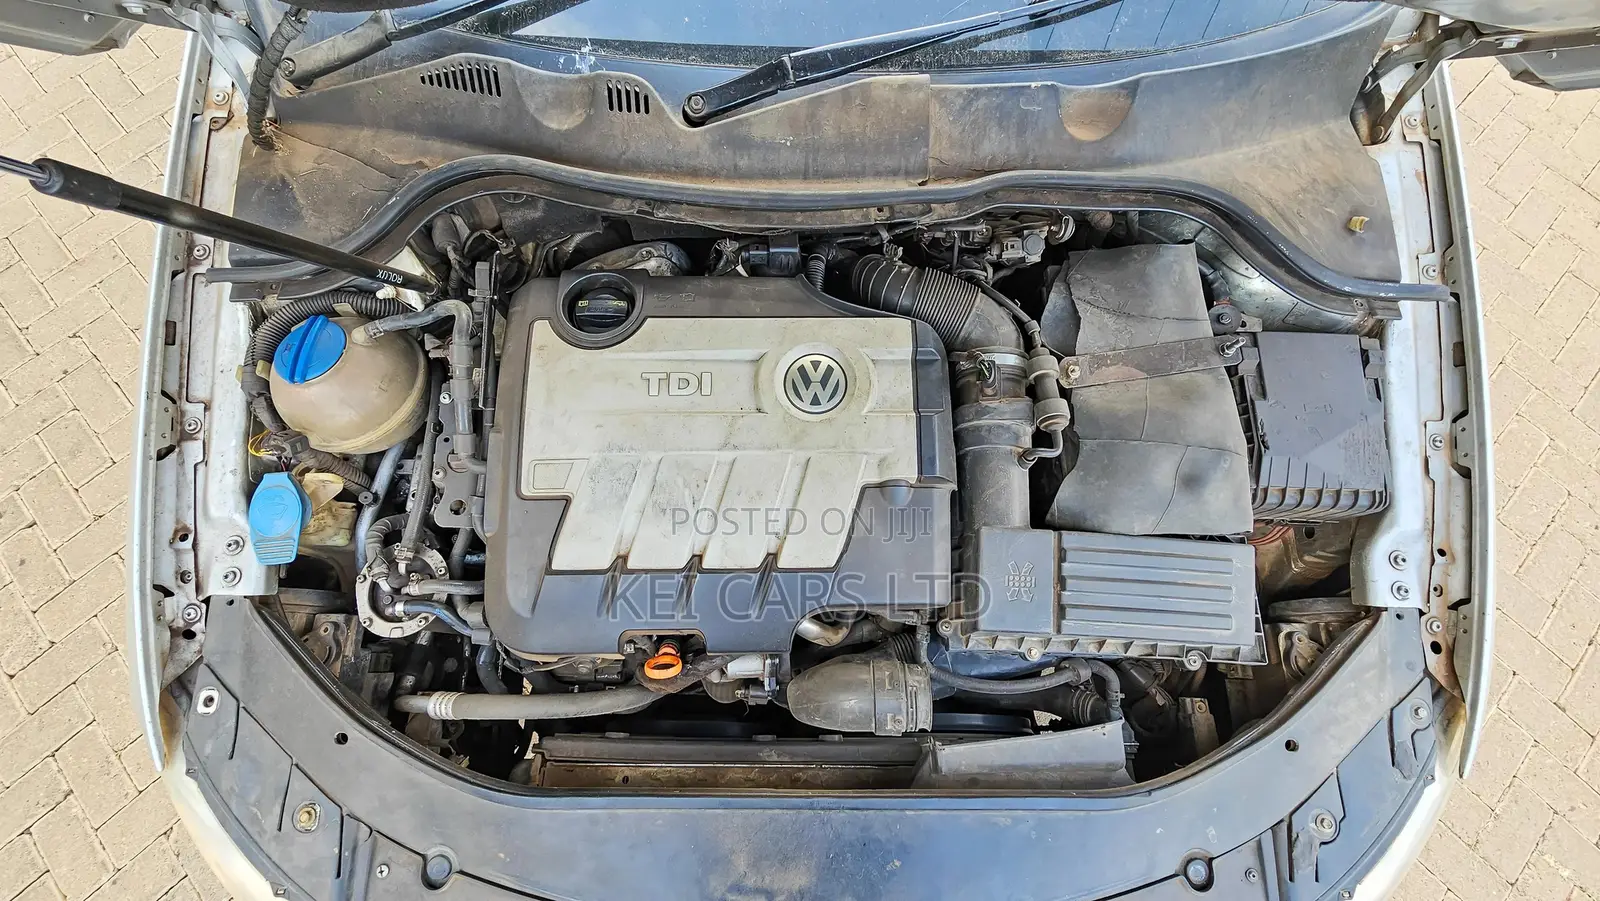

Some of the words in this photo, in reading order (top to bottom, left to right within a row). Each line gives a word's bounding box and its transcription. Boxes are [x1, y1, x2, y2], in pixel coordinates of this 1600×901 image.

[376, 269, 403, 284] ROLUX
[641, 372, 712, 396] TDI
[784, 353, 848, 414] VW
